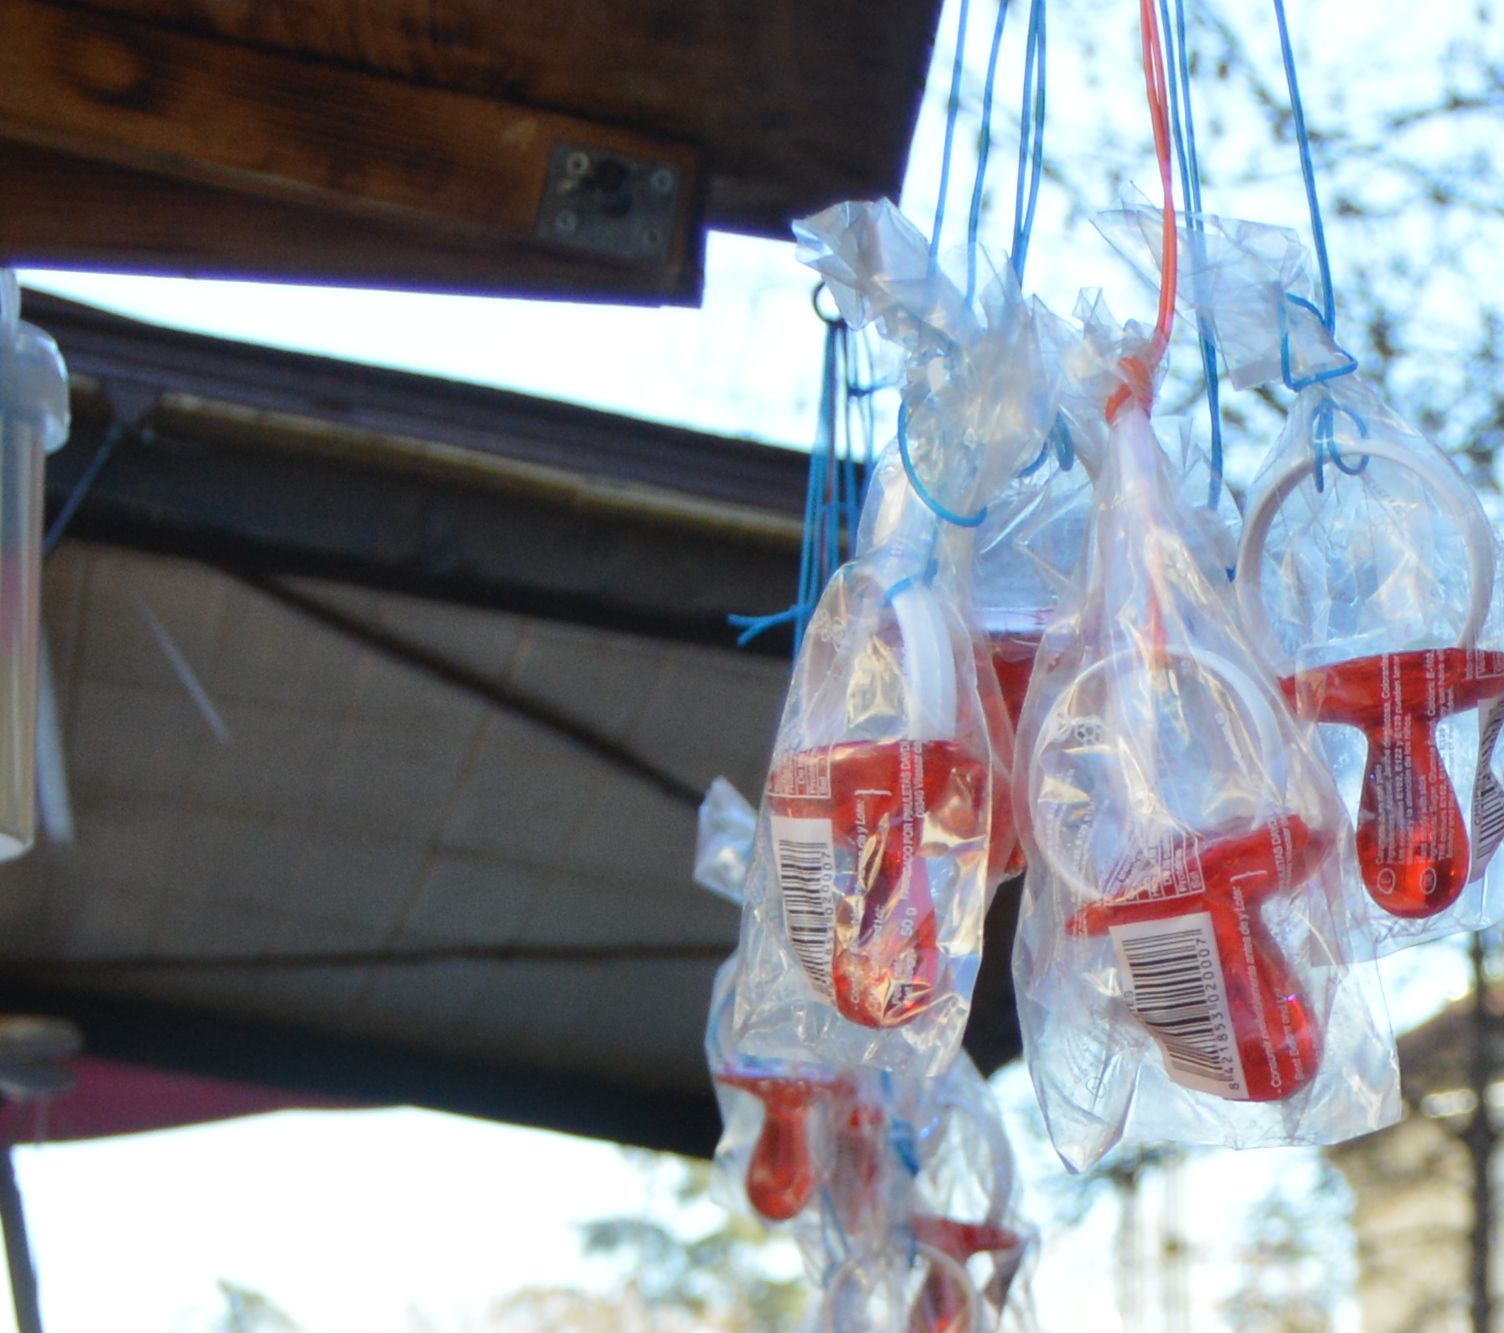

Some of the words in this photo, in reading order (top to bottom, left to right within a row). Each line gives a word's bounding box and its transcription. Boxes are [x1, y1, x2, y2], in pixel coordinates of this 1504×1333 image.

[902, 823, 914, 844] POR
[905, 906, 919, 917] g
[900, 918, 914, 937] 50
[1197, 938, 1220, 1004] 020007
[1211, 1012, 1235, 1077] 421853
[1227, 1082, 1240, 1092] 8
